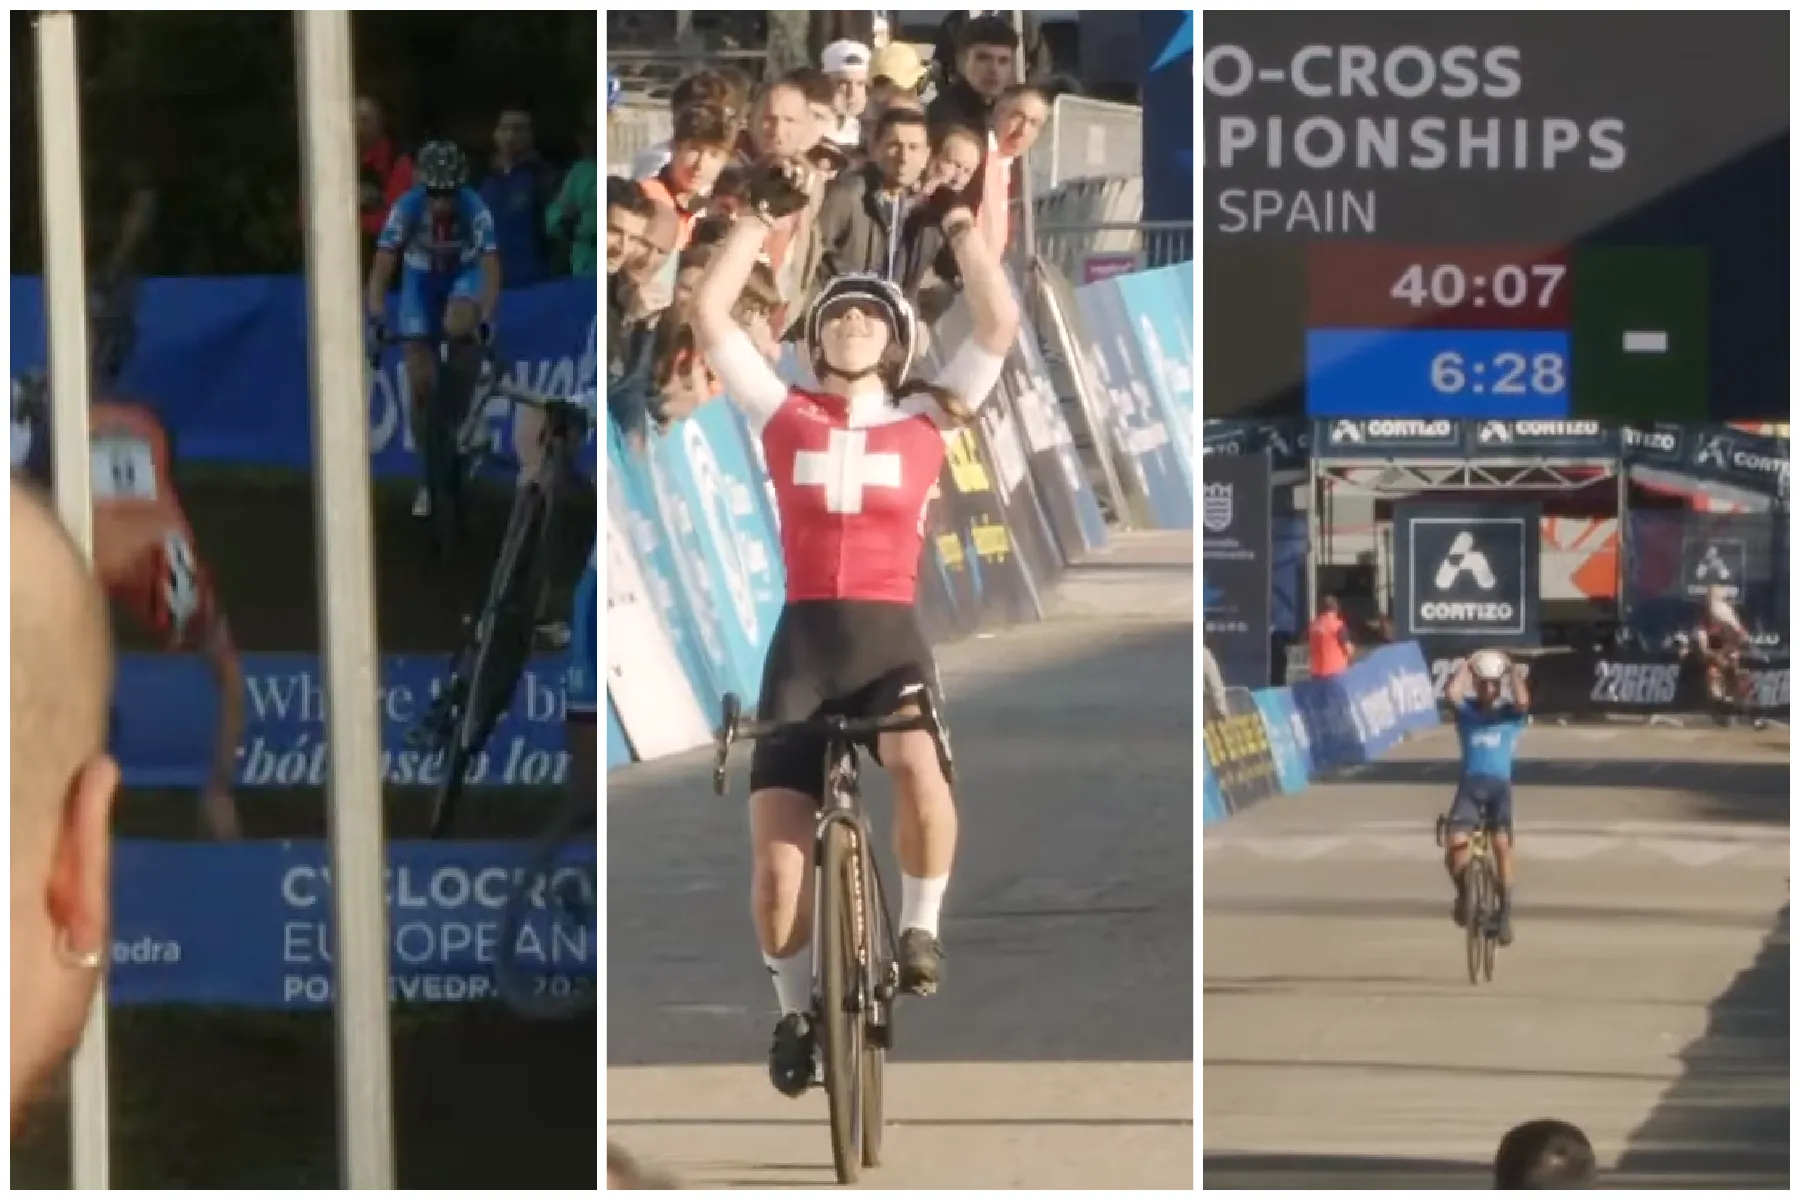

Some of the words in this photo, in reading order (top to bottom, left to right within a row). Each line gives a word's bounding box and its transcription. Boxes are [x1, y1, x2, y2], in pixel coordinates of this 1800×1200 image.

[1203, 45, 1522, 98] O-CROSS
[1203, 117, 1627, 170] PIONSHIPS
[1218, 189, 1376, 233] SPAIN
[1390, 264, 1567, 307] 40:07
[1430, 352, 1566, 394] 6:28
[1368, 419, 1451, 437] CORTIZO
[1420, 602, 1513, 621] CORTIZO
[284, 922, 588, 961] EUOPEAN
